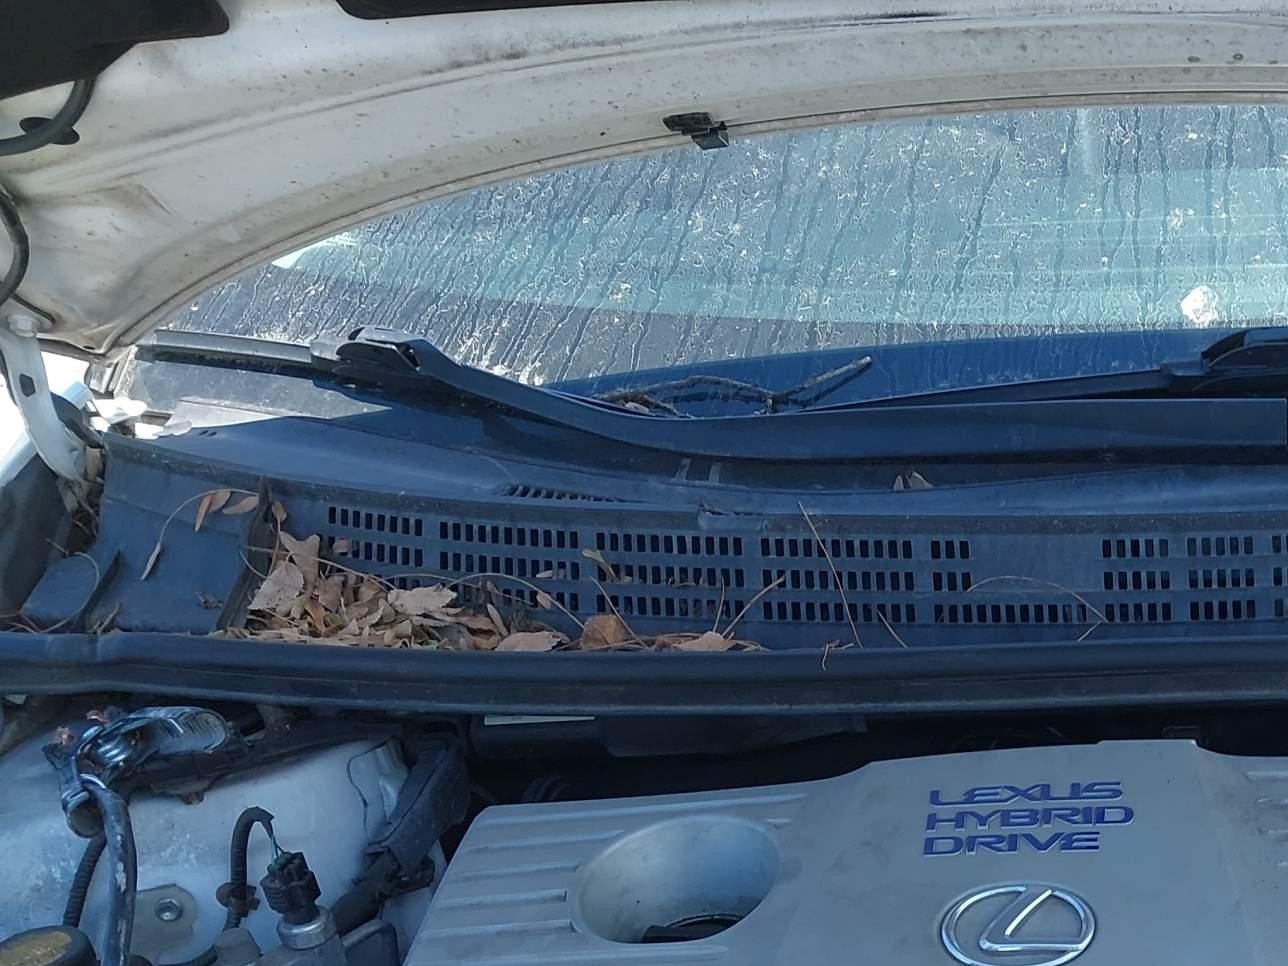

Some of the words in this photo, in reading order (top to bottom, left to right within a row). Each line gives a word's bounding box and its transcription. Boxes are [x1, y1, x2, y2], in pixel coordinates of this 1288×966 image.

[929, 781, 1123, 806] LEXUS
[925, 806, 1135, 832] HYBRID
[923, 832, 1101, 857] DRIVE
